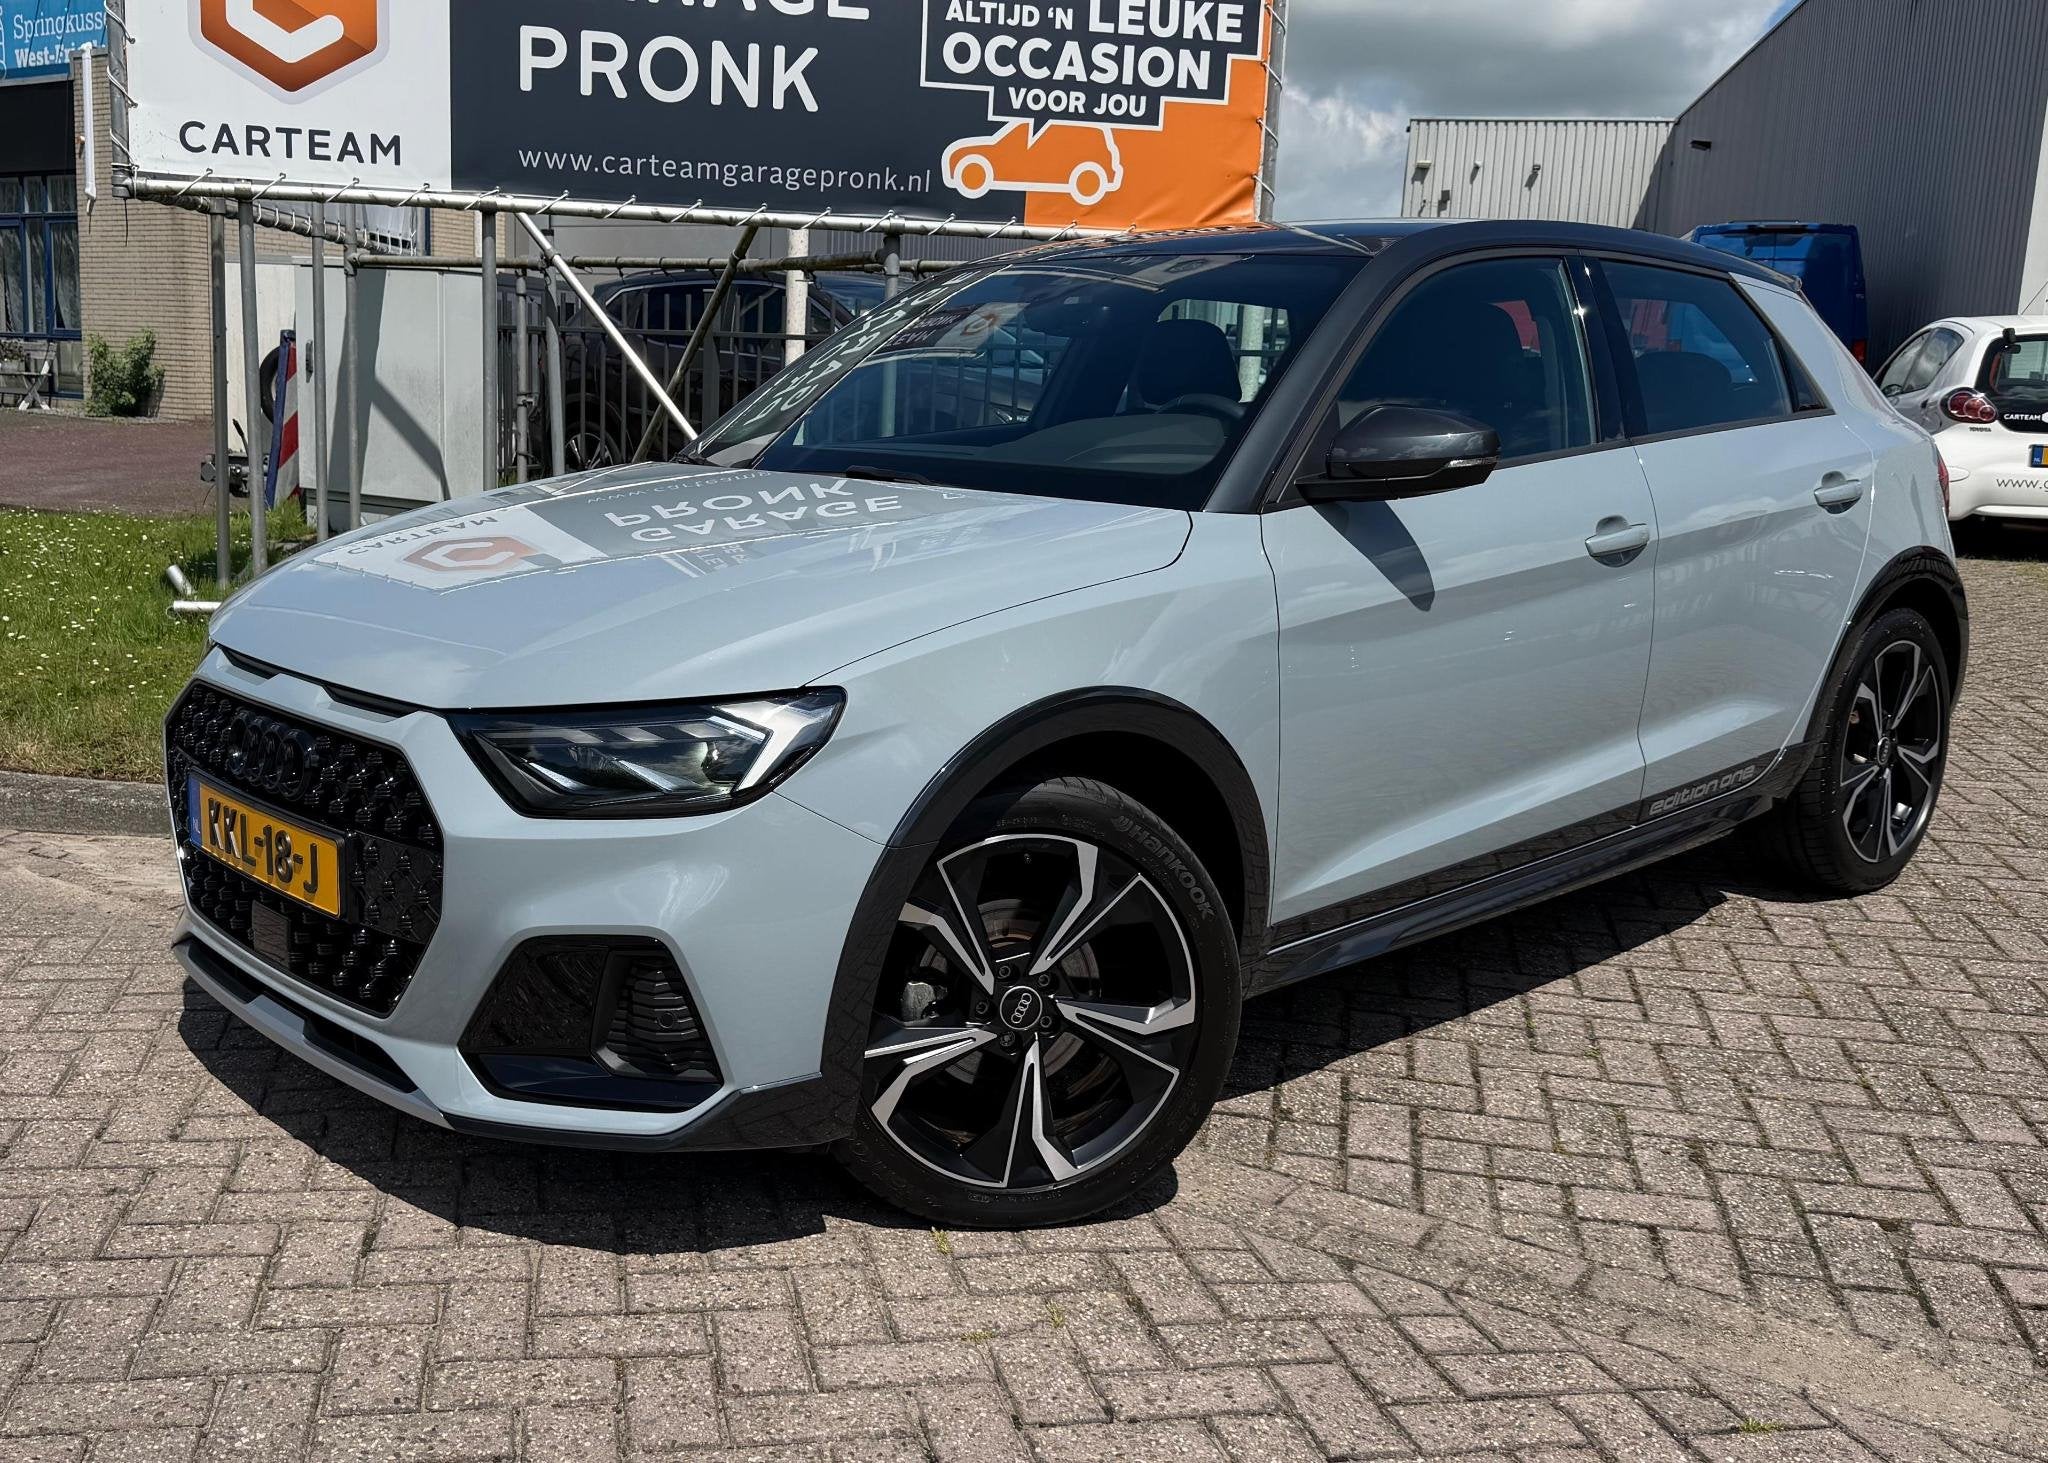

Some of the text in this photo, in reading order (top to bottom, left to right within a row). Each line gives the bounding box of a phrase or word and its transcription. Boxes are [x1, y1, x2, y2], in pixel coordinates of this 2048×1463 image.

[945, 0, 1040, 27] ALTIJD
[1089, 0, 1245, 43] LEUKE
[519, 25, 819, 112] PRONK
[942, 31, 1212, 90] OCCASION
[1008, 86, 1147, 117] VOOR JOU
[179, 120, 401, 167] CARTEAM
[518, 148, 932, 193] www.carteamgaragepronk.nl
[2003, 413, 2041, 421] CARTEAM
[1650, 765, 1756, 816] edition one
[207, 797, 319, 894] KKL-18-J
[1128, 824, 1215, 920] Hankook
